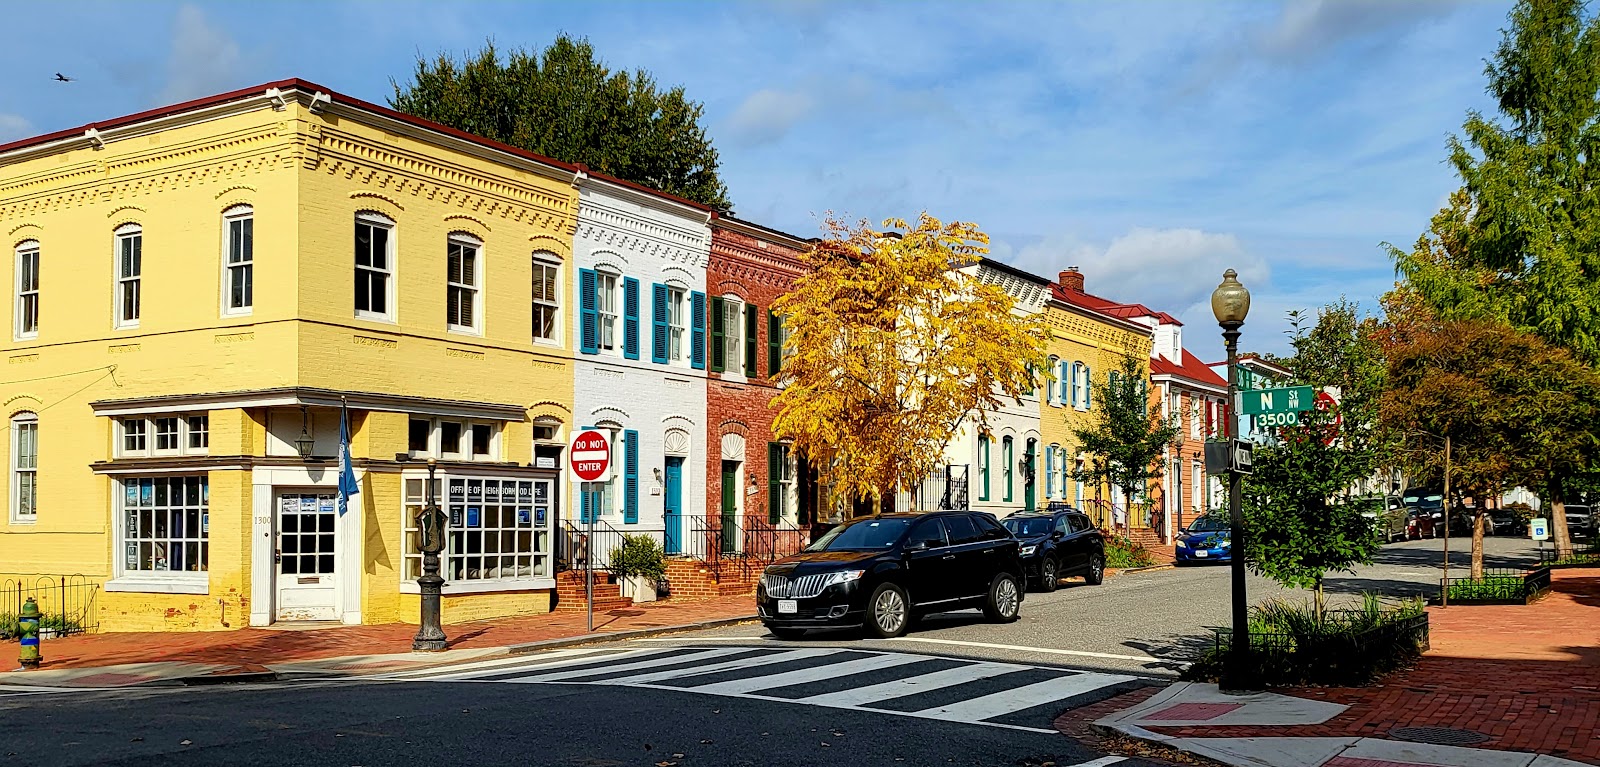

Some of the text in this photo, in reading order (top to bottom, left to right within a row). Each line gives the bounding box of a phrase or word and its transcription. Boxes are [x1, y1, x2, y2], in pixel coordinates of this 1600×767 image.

[1261, 390, 1298, 410] N St
[1288, 399, 1299, 409] NW
[1259, 412, 1296, 426] 3500
[575, 440, 604, 450] DO NOT
[578, 462, 601, 472] ENTER
[451, 486, 473, 494] OFFIE
[528, 488, 541, 496] LFE
[254, 516, 272, 525] 1300
